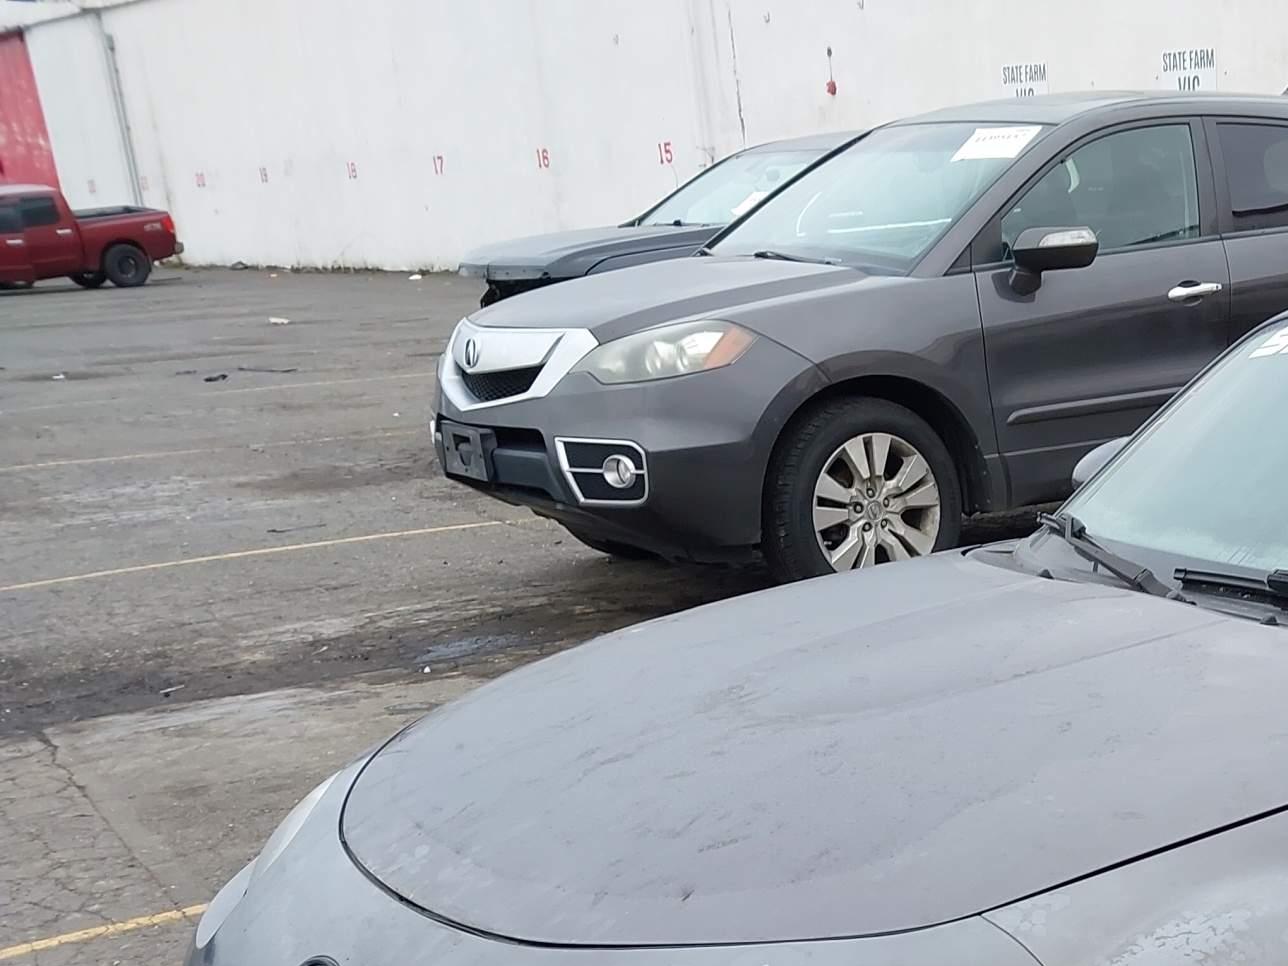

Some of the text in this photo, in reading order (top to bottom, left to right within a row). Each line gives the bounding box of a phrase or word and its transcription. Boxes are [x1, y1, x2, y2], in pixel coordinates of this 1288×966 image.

[1162, 48, 1215, 72] STATE FARM
[1002, 63, 1047, 85] STATE FARM
[536, 148, 550, 168] 16
[658, 142, 673, 165] 15
[432, 155, 444, 175] 17
